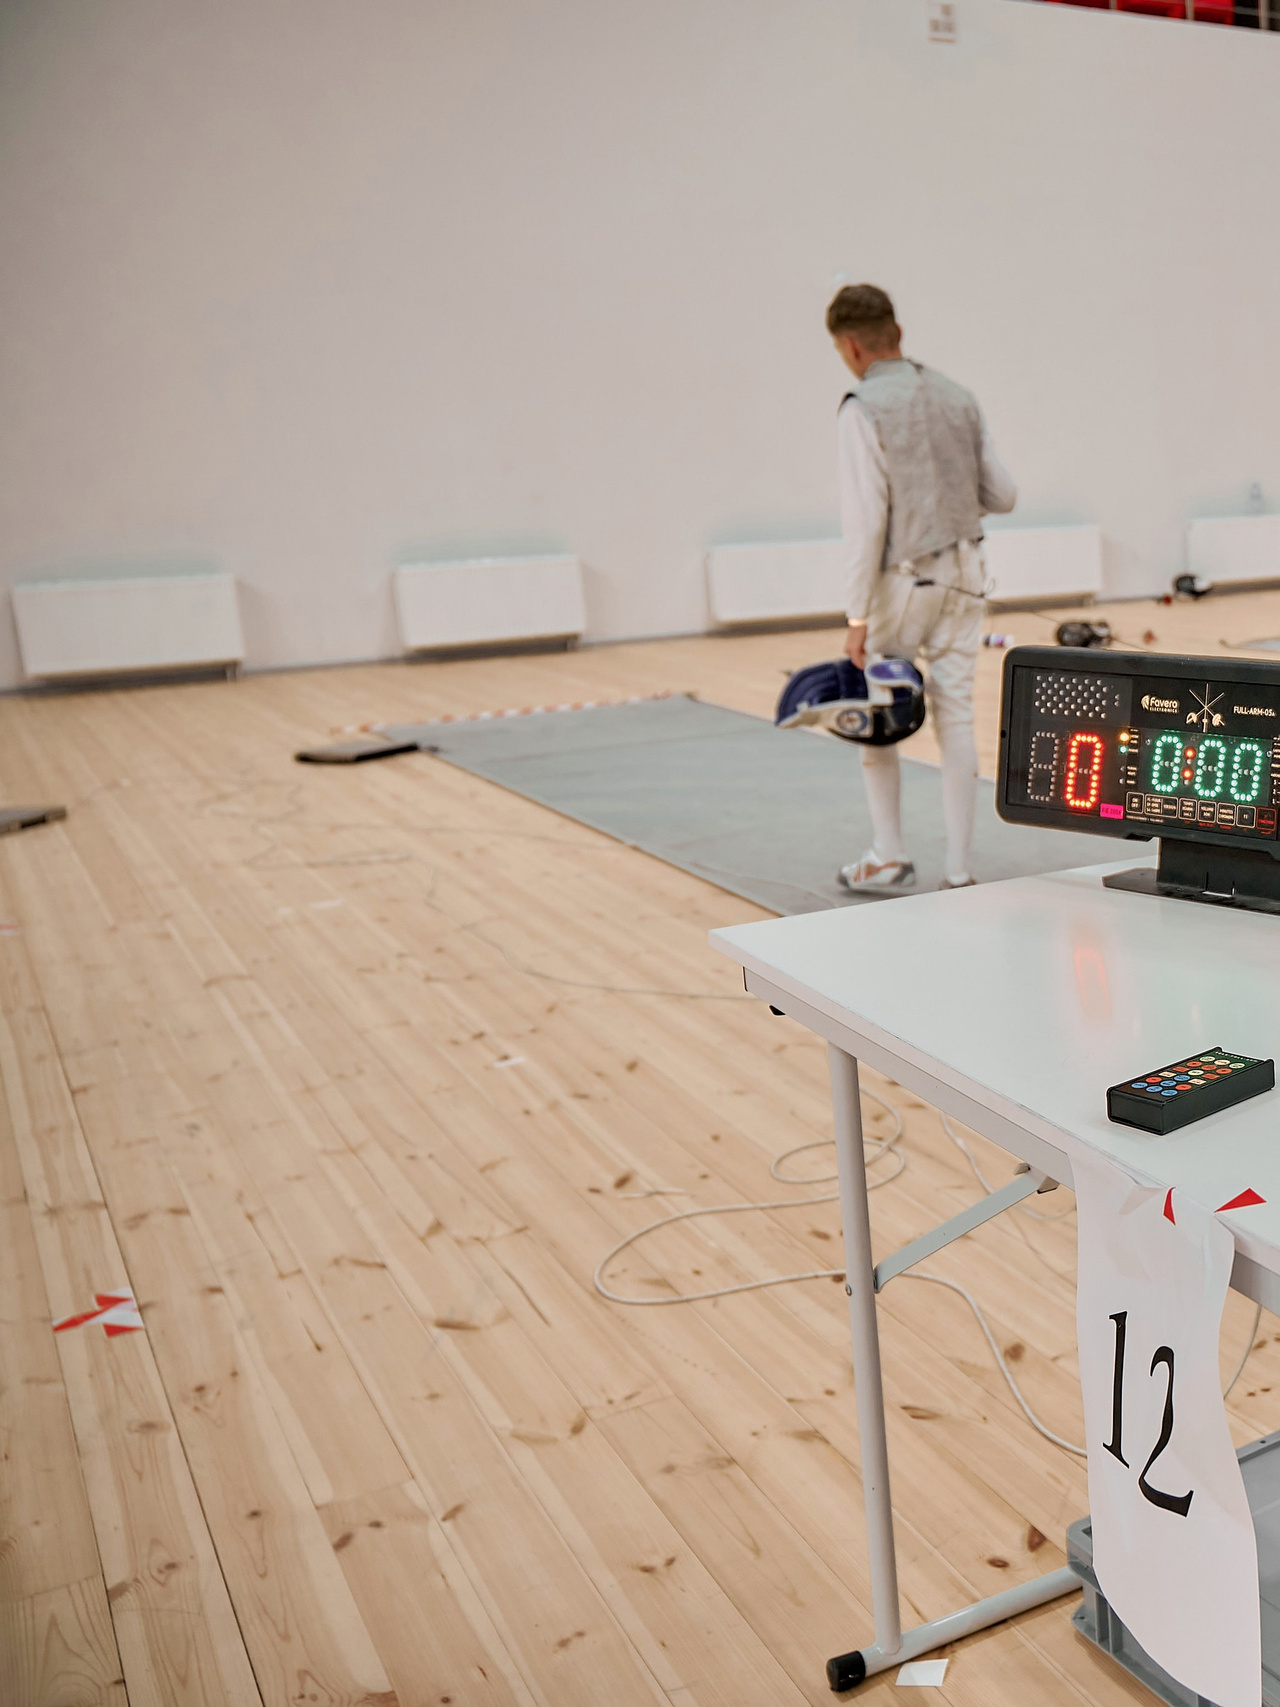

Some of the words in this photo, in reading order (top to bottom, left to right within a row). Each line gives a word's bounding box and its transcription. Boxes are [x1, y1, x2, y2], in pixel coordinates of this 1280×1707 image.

[1150, 696, 1178, 709] Favero
[1064, 733, 1103, 809] 0
[1102, 1310, 1194, 1518] 12
